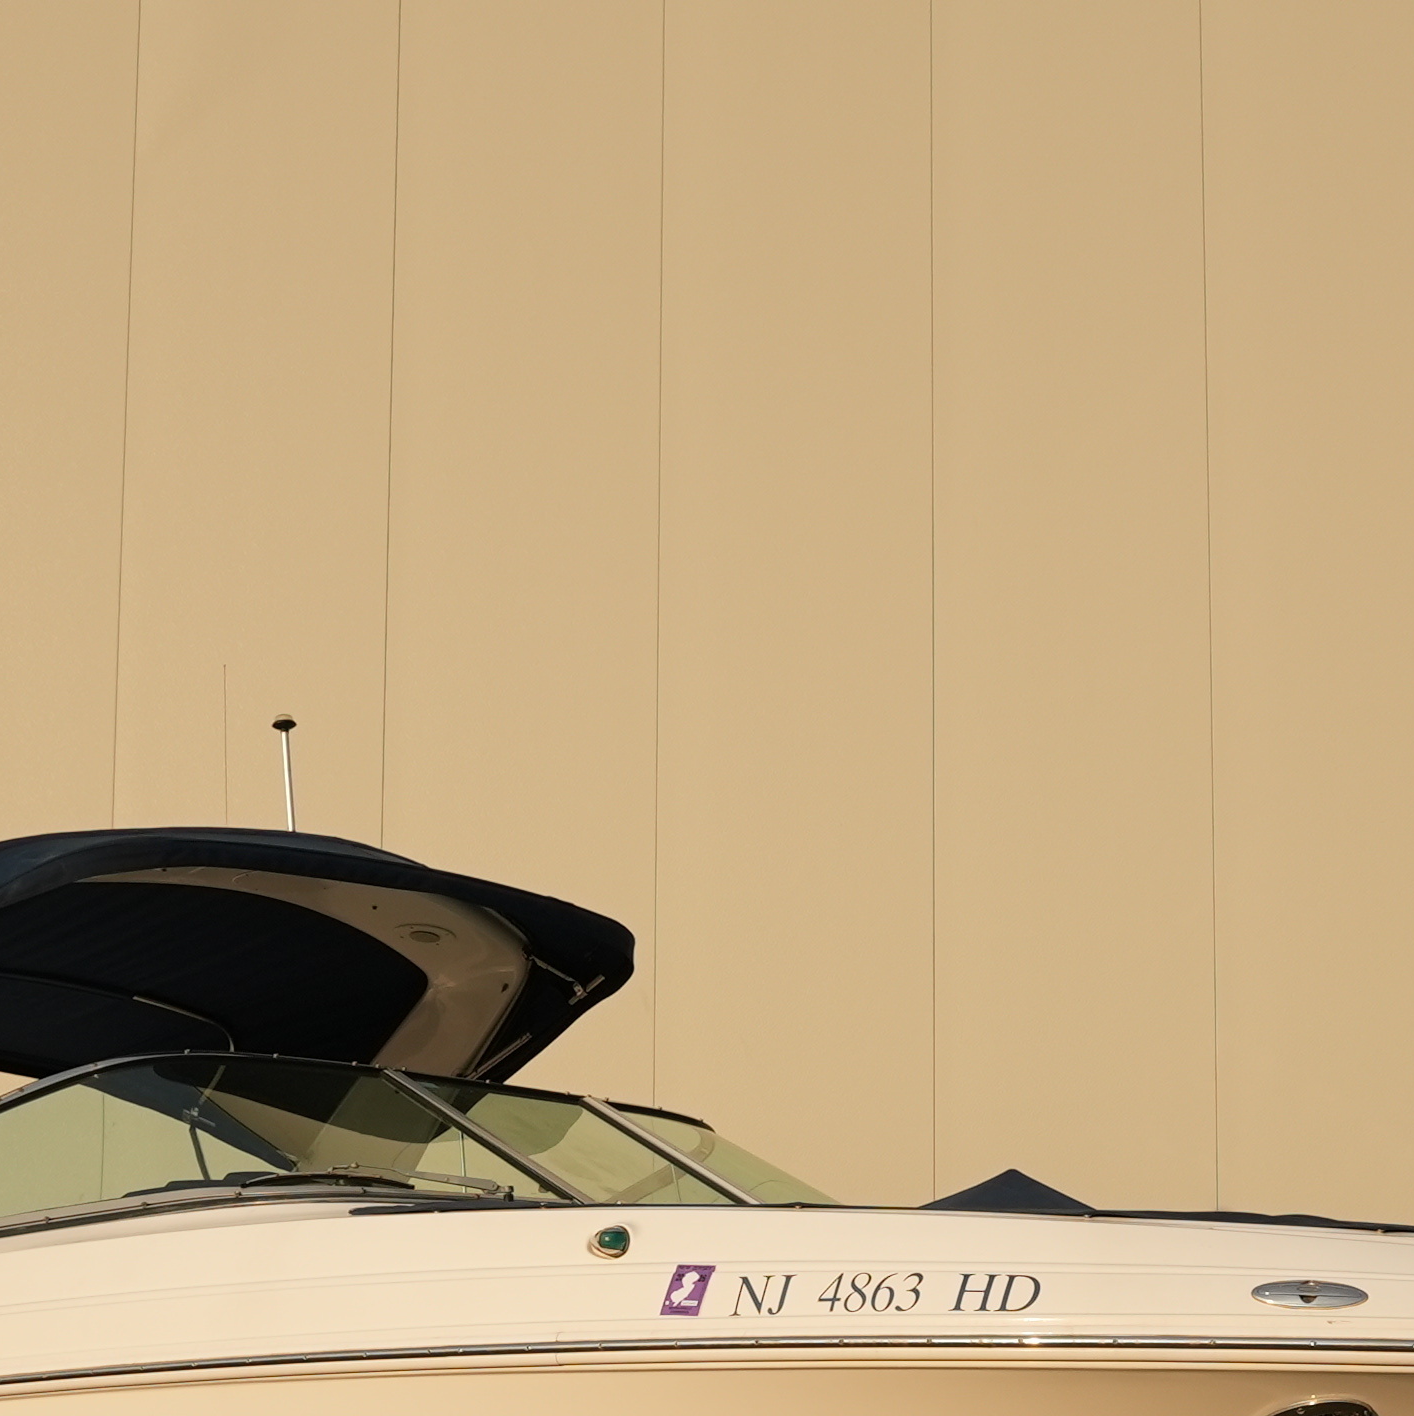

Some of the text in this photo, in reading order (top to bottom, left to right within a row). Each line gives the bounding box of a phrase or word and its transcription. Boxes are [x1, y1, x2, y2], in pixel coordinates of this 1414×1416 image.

[729, 1272, 1041, 1317] NJ 4863 HD
